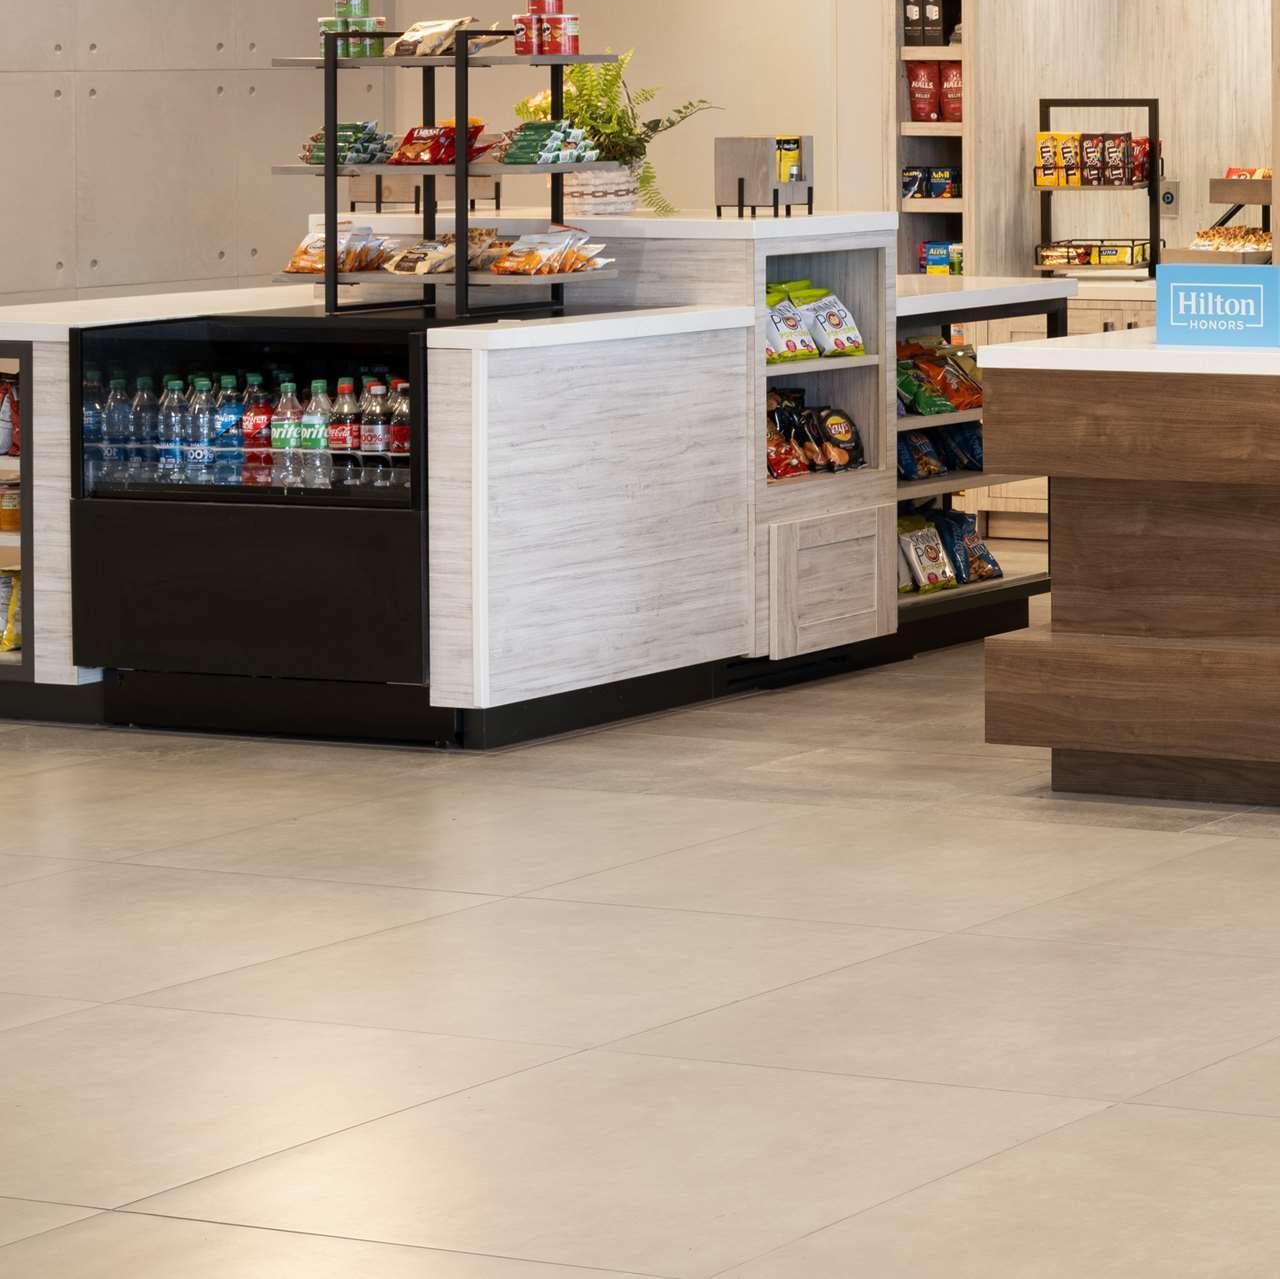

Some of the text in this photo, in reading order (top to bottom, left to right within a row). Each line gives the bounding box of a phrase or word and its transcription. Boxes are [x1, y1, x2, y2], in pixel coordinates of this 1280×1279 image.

[911, 81, 934, 89] HALLS
[943, 81, 962, 89] HALL
[1178, 291, 1255, 316] Hilton
[1190, 320, 1245, 331] HONORS
[271, 424, 301, 438] prite
[187, 449, 214, 461] 00%
